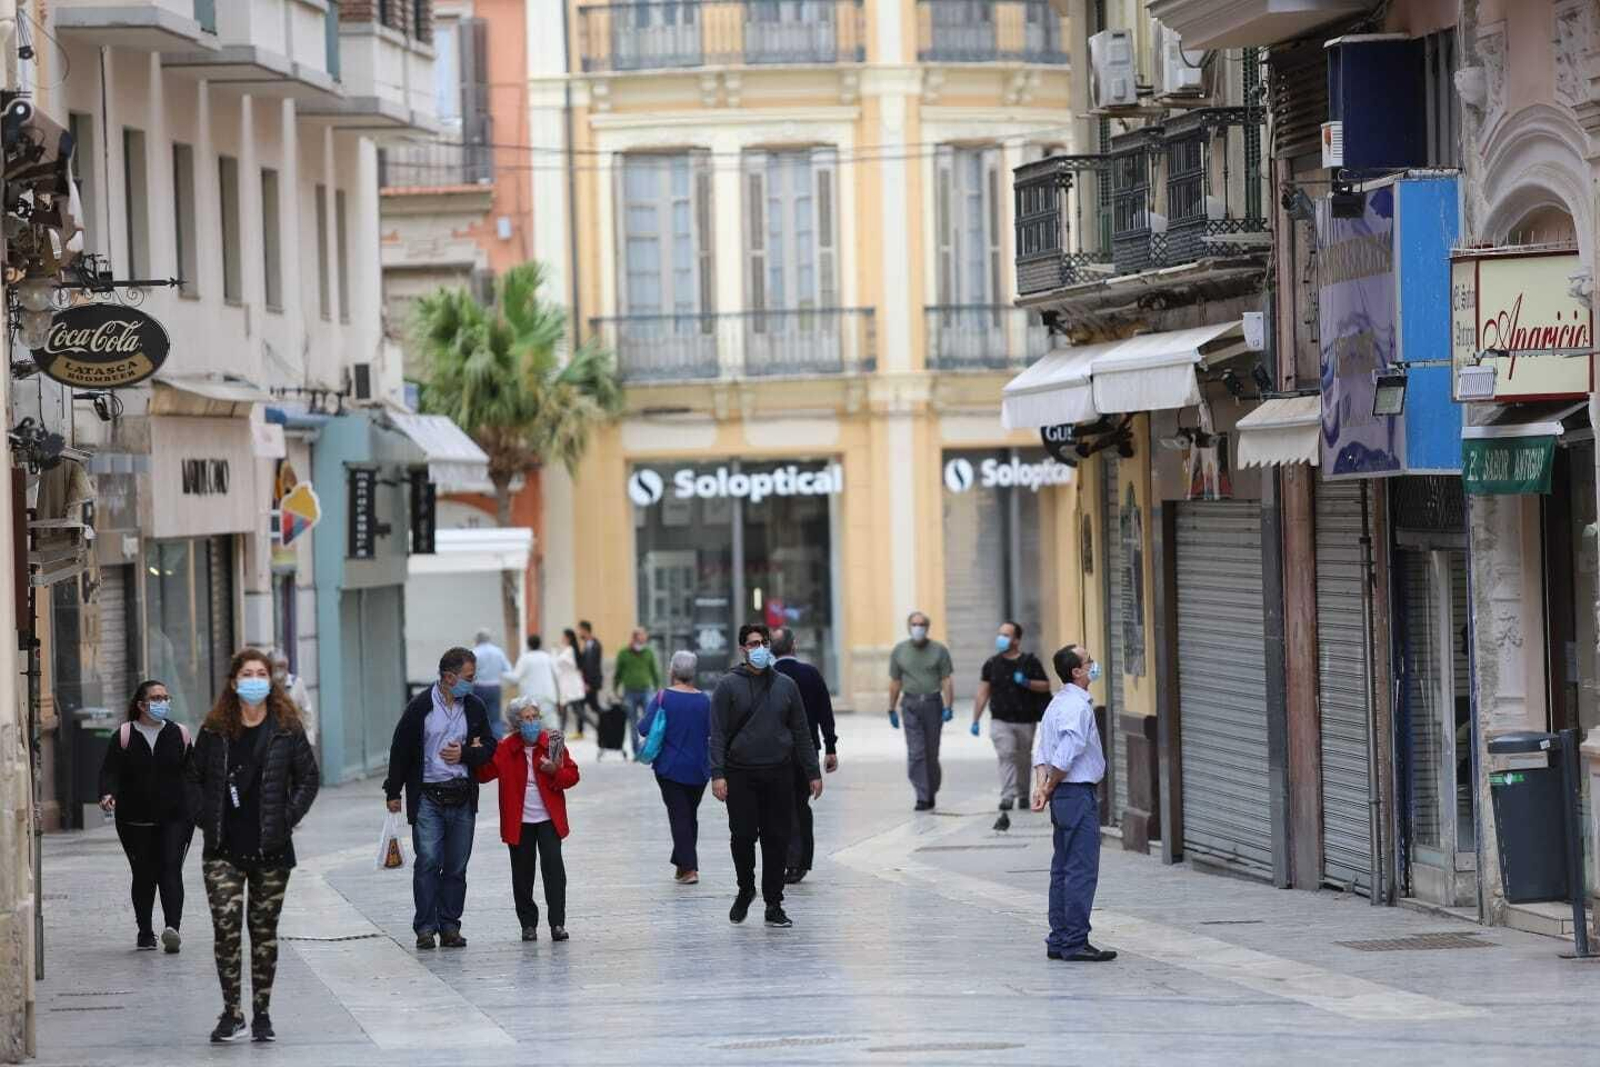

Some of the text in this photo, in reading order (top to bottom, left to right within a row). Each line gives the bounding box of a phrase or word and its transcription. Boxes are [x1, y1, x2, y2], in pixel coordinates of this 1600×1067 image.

[44, 320, 143, 354] Coca-Cola
[1483, 293, 1589, 381] Aparicio
[673, 464, 844, 504] Soloptical
